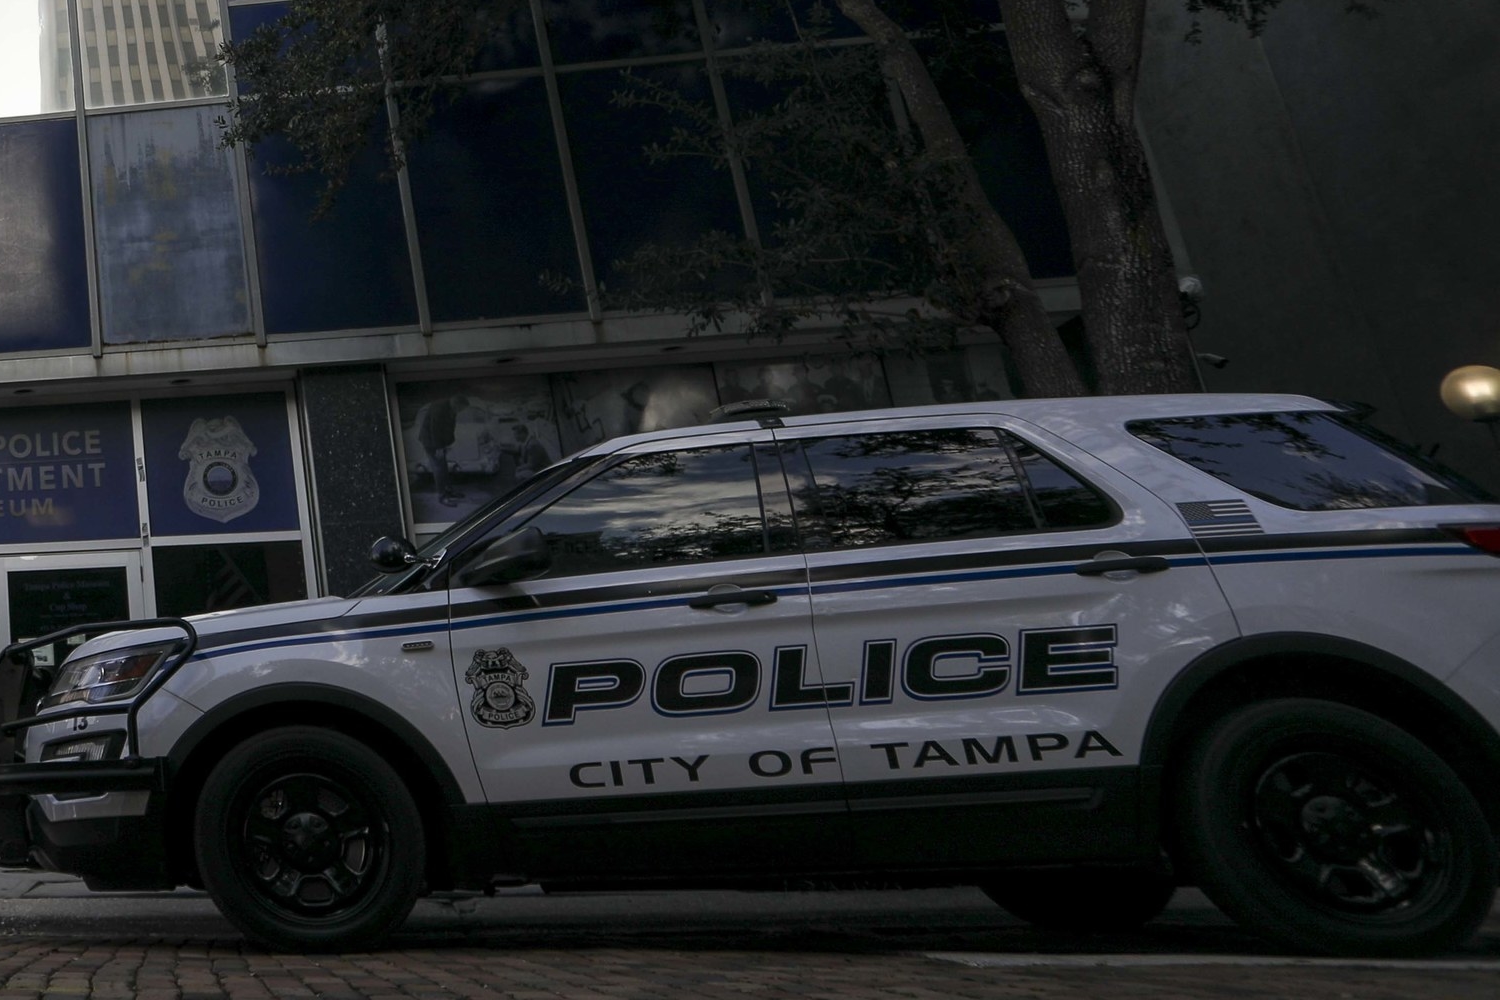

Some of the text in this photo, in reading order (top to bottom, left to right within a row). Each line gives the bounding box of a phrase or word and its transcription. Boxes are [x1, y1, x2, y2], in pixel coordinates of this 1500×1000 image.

[199, 450, 238, 459] TAMPA
[201, 496, 244, 507] POLICE
[484, 674, 512, 683] TAMPA
[541, 623, 1118, 727] POLICE
[488, 711, 519, 721] POLICE
[569, 730, 1124, 788] CITY OF TAMPA
